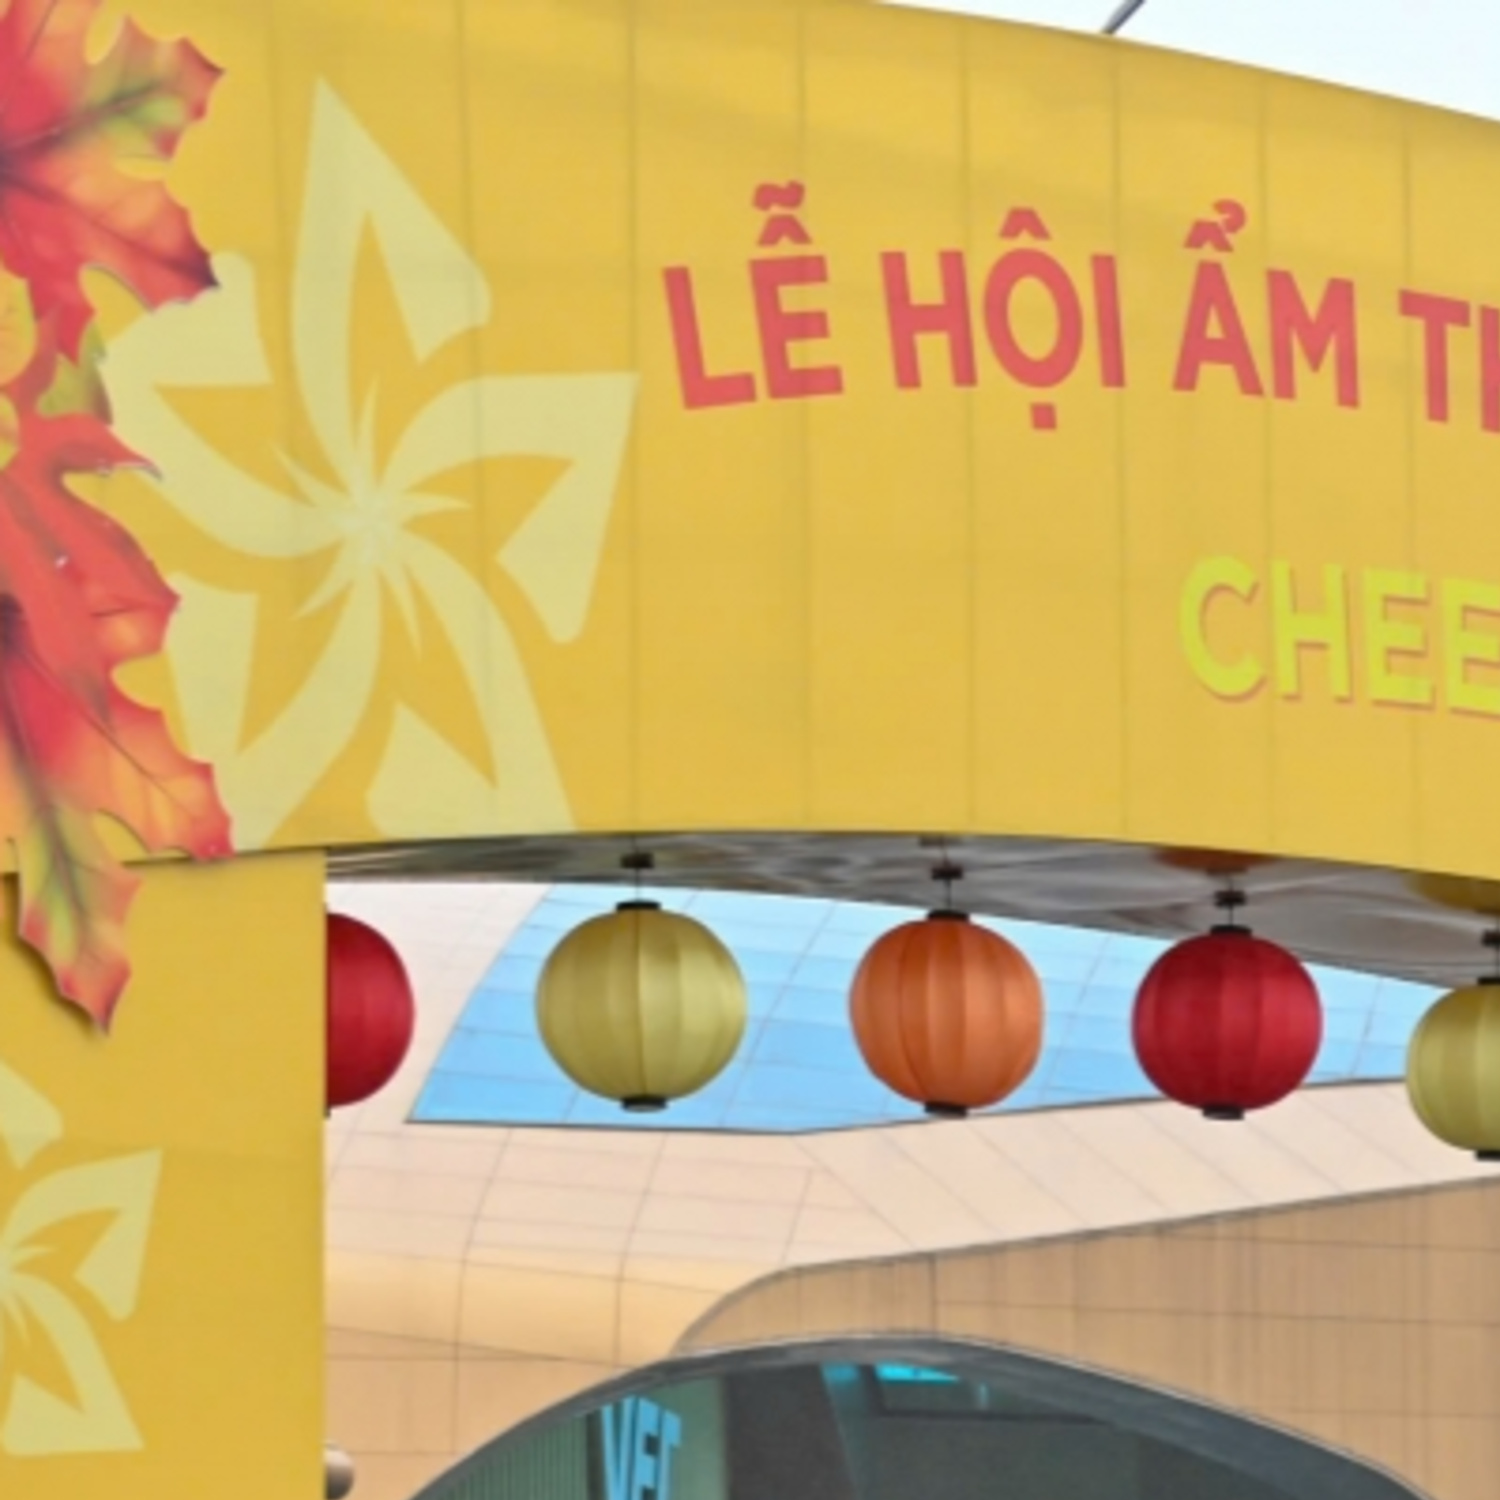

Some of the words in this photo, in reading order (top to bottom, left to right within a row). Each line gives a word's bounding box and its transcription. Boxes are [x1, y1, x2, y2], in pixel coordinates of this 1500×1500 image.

[662, 181, 844, 410] LỄ
[880, 207, 1126, 431] HỘI
[1172, 199, 1361, 409] ẨM
